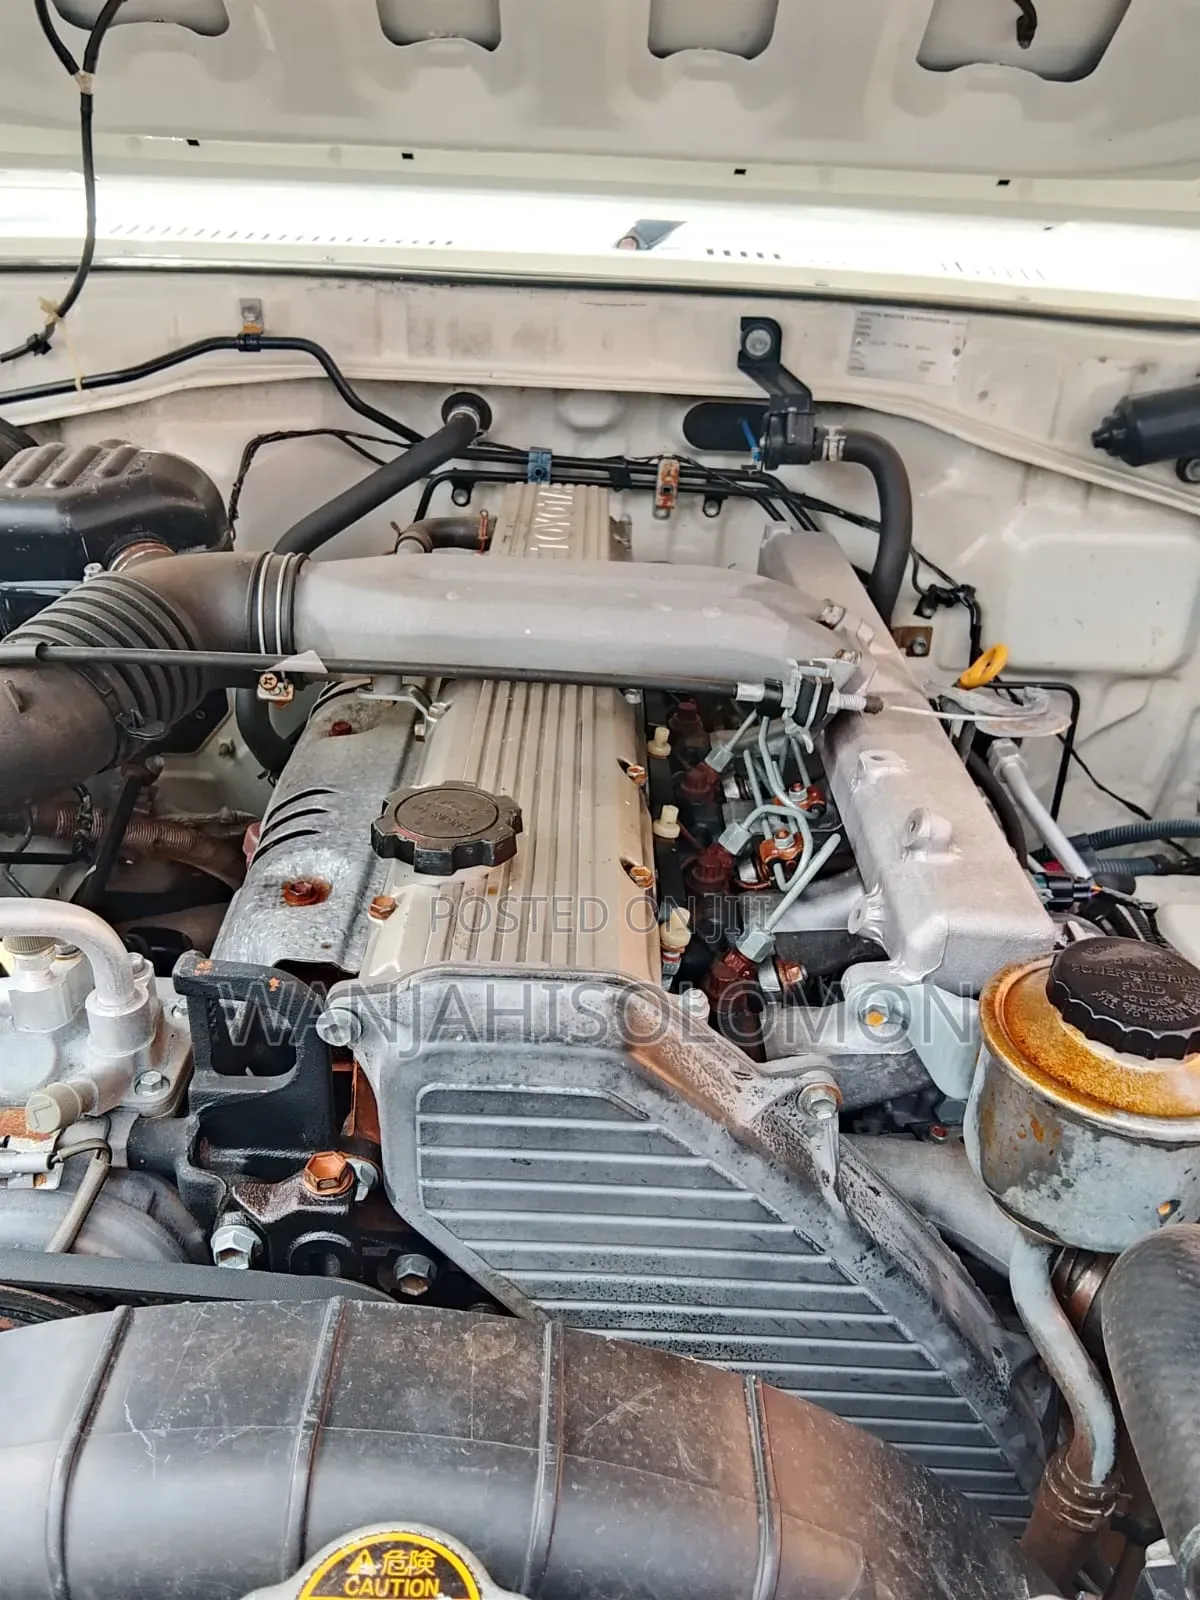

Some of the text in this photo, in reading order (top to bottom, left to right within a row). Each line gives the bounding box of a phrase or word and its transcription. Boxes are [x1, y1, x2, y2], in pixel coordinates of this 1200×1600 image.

[1071, 963, 1126, 978] POWER
[380, 1549, 437, 1577] 危険
[343, 1578, 440, 1598] CAUTION
